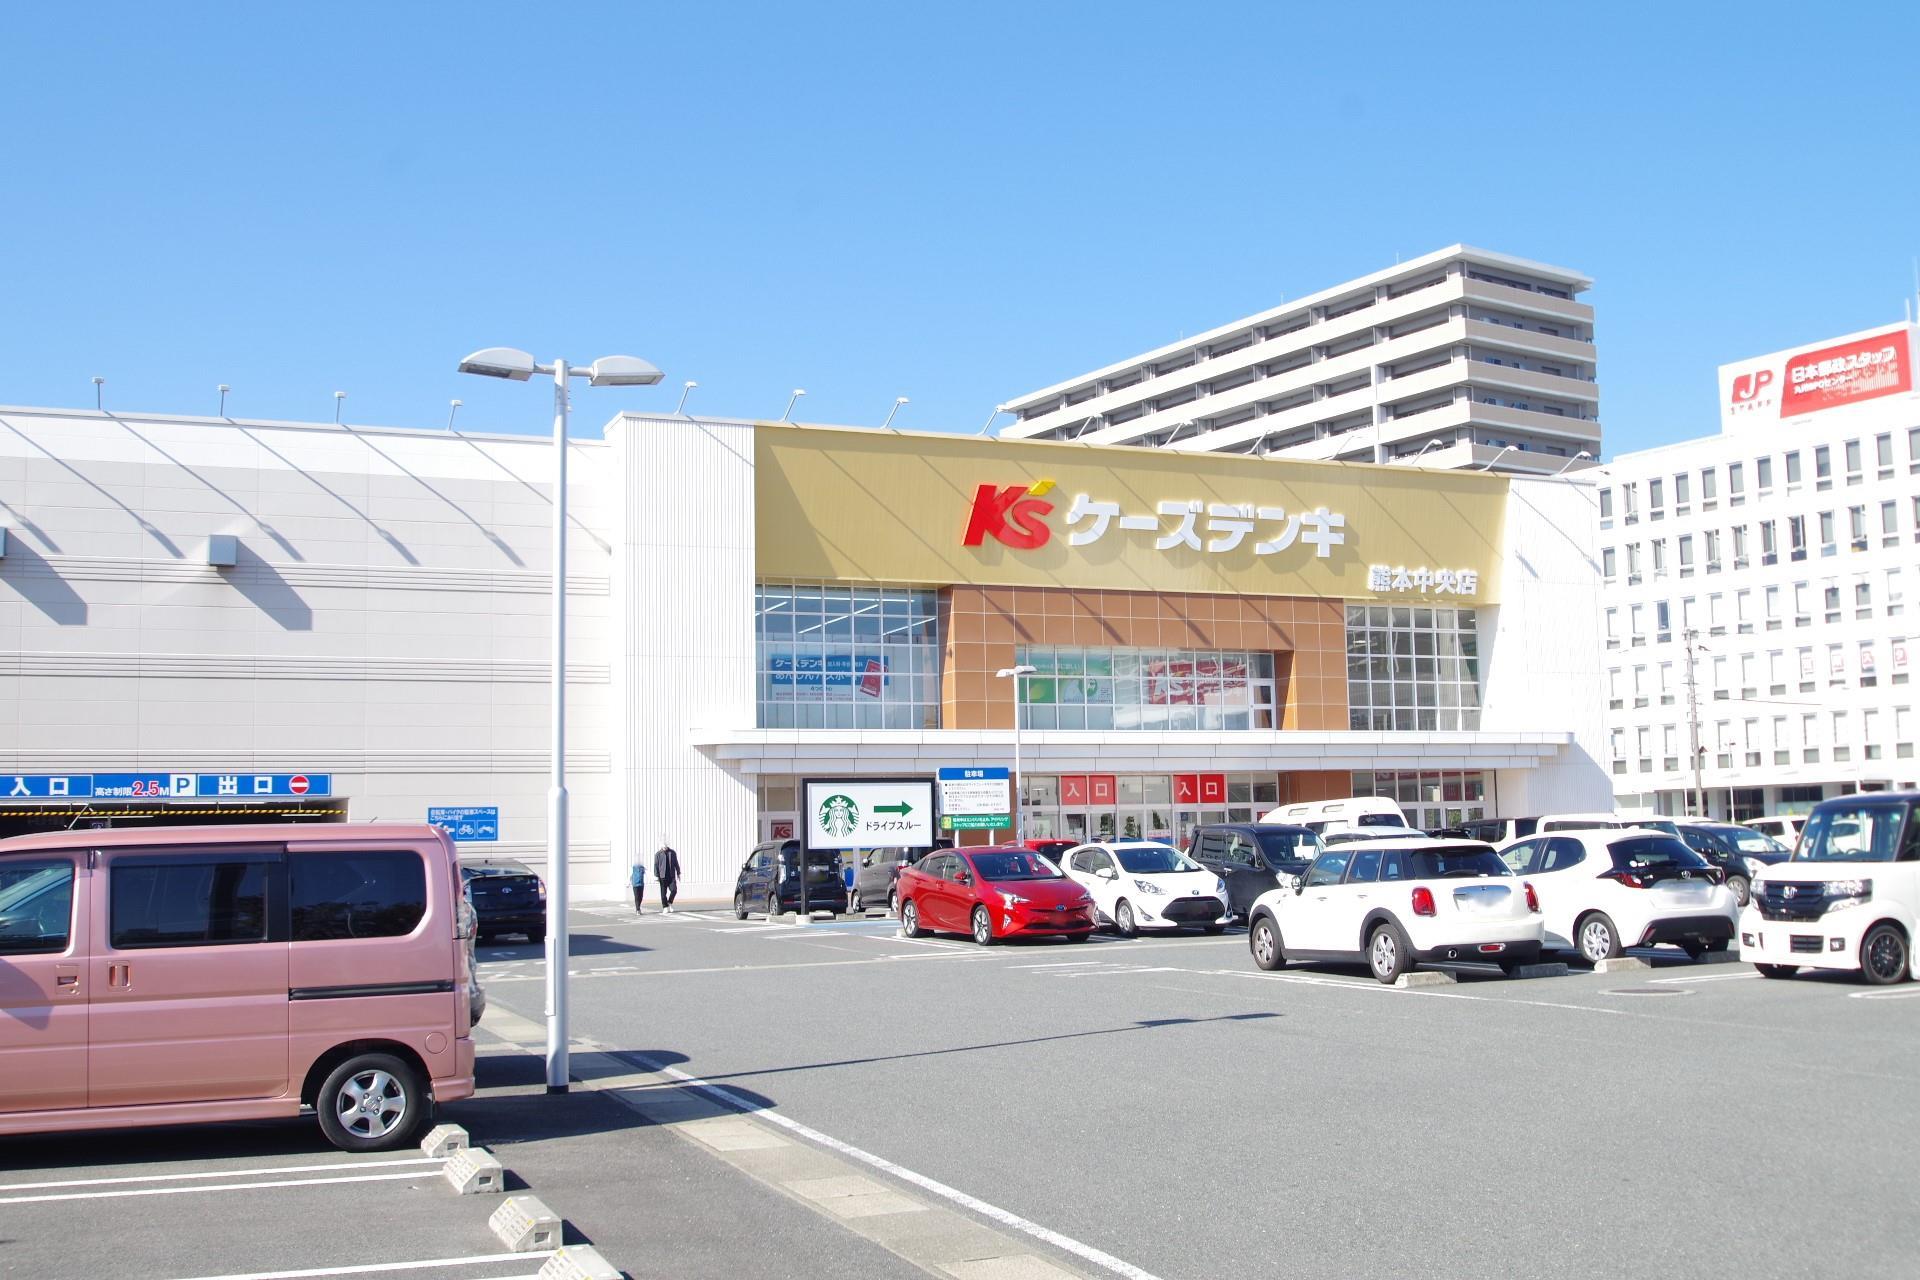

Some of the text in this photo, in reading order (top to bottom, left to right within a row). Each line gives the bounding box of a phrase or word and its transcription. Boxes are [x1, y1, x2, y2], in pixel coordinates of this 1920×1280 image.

[1732, 369, 1774, 403] JP
[1066, 493, 1346, 559] ケーズデンキ
[1367, 564, 1478, 596] 熊本中央店
[10, 777, 69, 796] 入口
[176, 777, 190, 793] P
[218, 775, 273, 794] 出口
[1067, 783, 1108, 797] 入口
[1179, 782, 1218, 796] 入口
[866, 820, 921, 831] ドライブスルー
